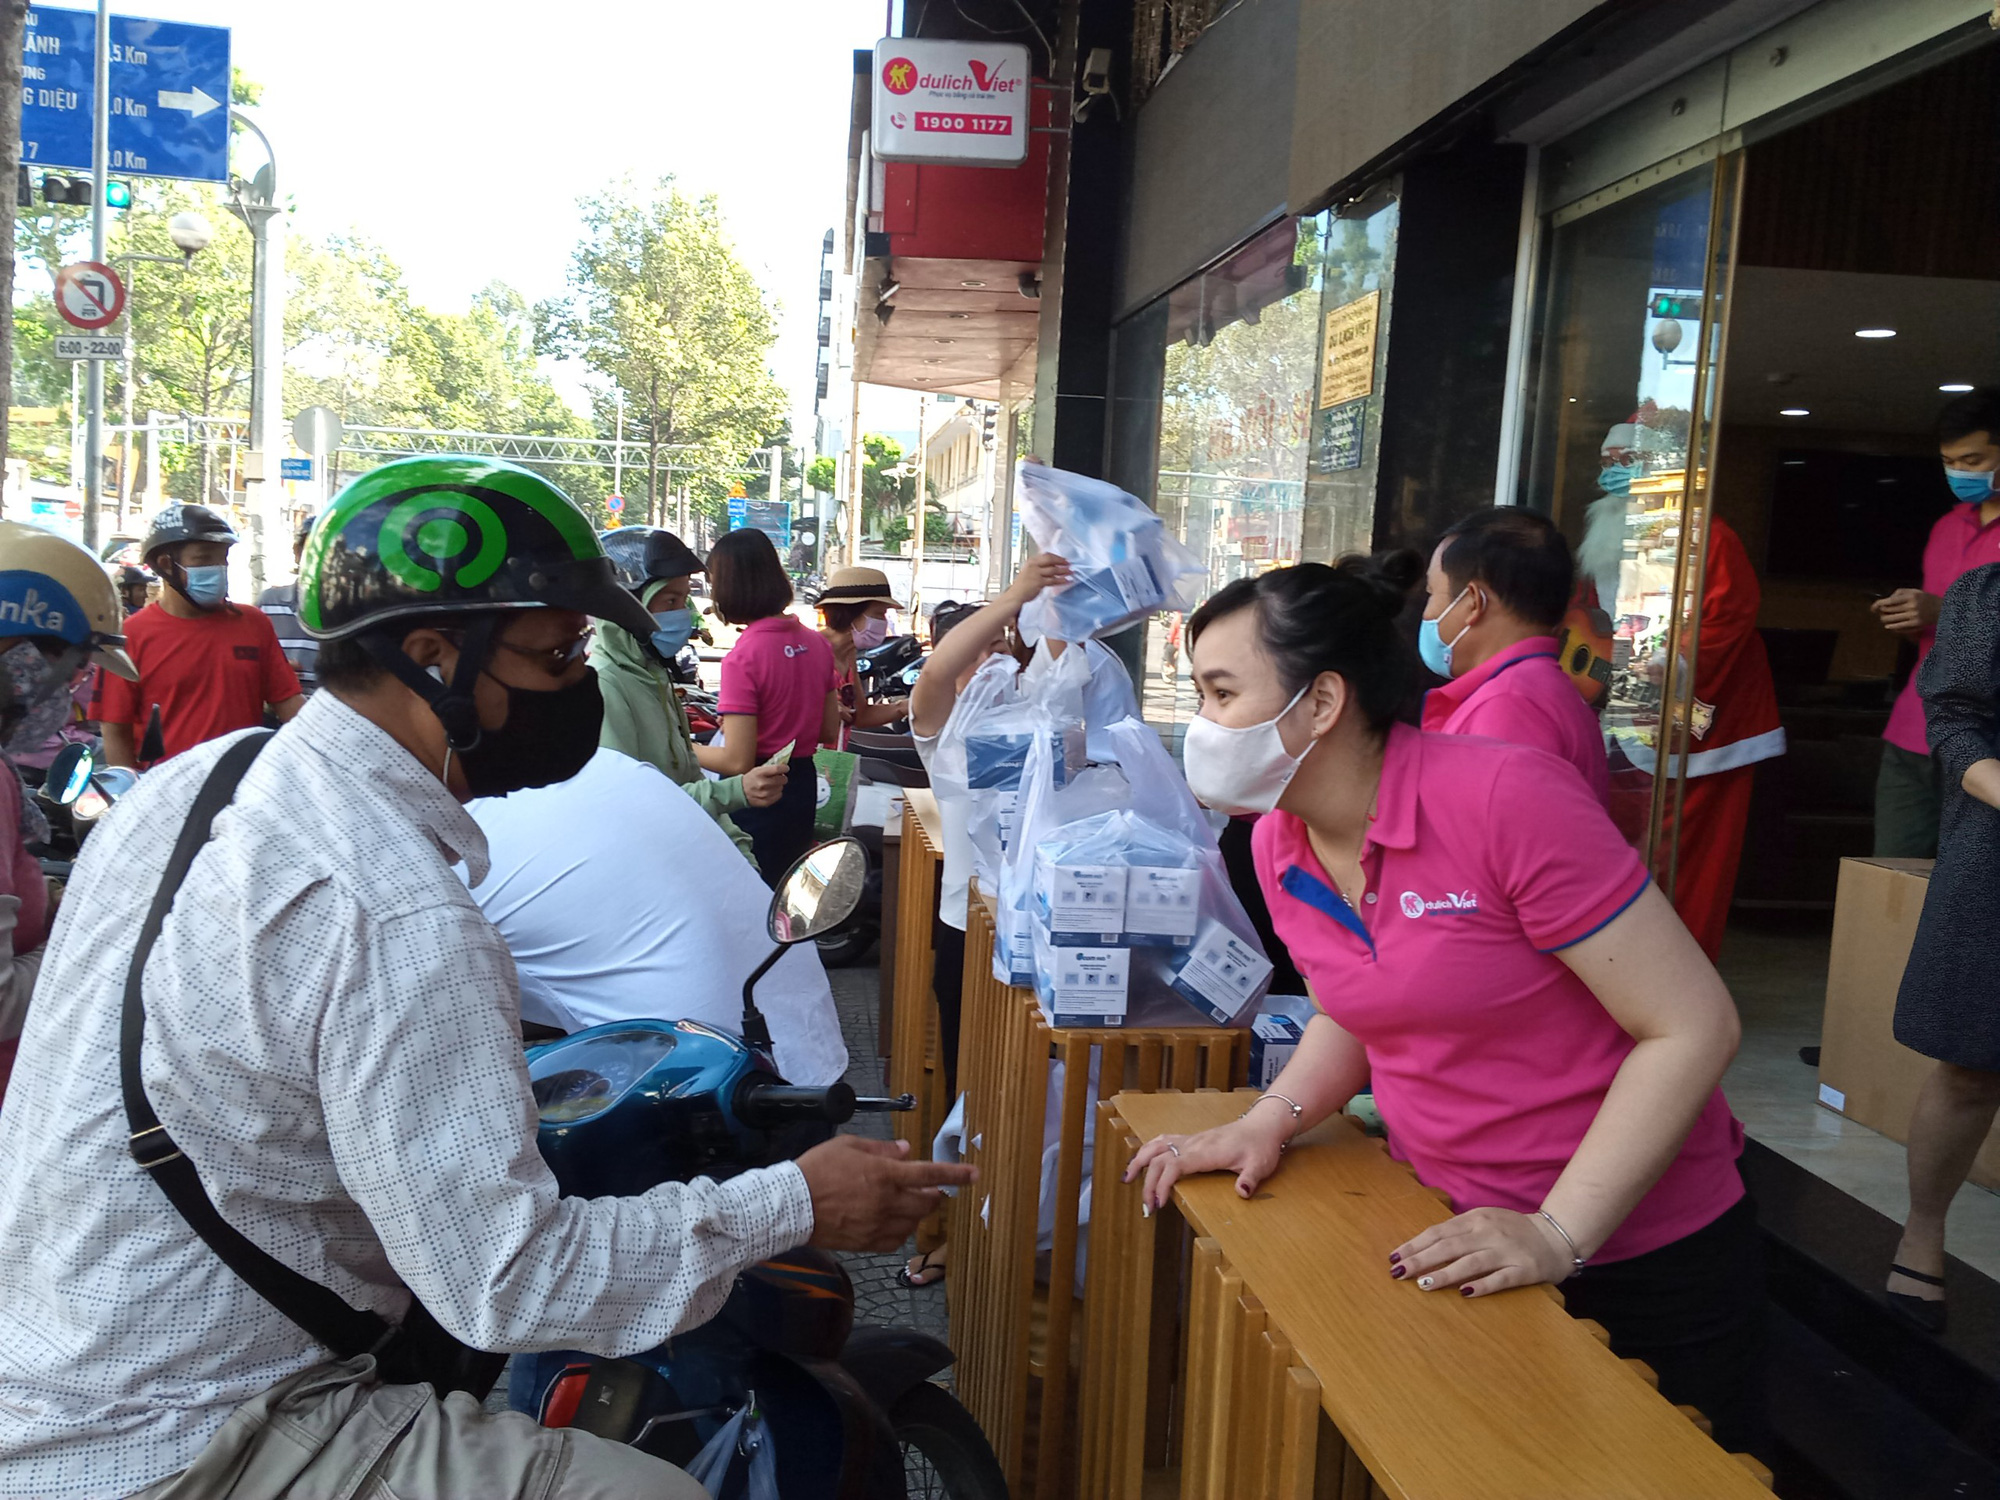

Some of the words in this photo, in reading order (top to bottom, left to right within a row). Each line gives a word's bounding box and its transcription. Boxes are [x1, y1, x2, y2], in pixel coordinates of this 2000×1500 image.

[125, 45, 148, 65] Km
[39, 87, 78, 112] DIỆU
[125, 97, 148, 118] Km
[921, 116, 965, 130] 1900
[972, 118, 1008, 132] 1177
[125, 150, 148, 170] Km
